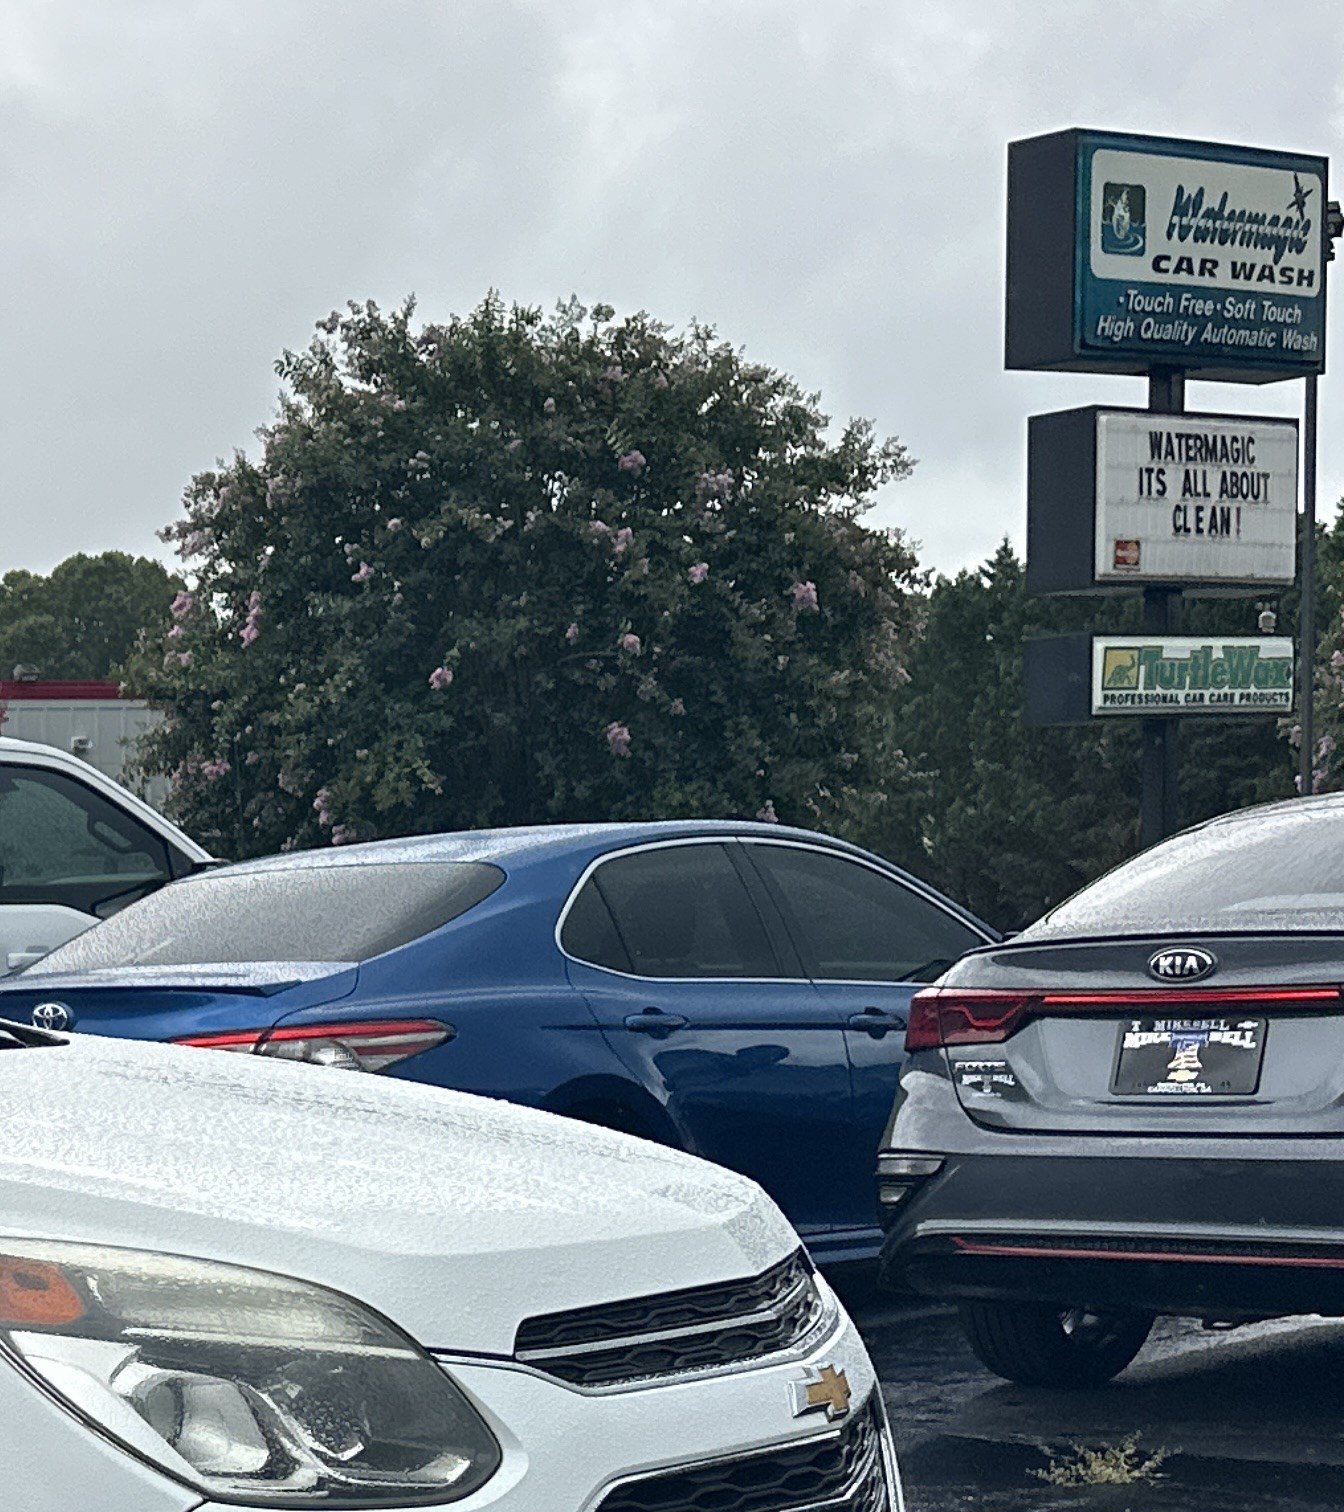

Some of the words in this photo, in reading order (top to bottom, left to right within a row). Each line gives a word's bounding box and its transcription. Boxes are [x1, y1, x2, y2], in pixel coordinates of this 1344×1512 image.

[1165, 182, 1312, 265] Watermagic
[1151, 254, 1219, 279] CAR
[1229, 260, 1316, 288] WASH
[1127, 289, 1174, 314] Touch
[1179, 293, 1214, 316] Free
[1223, 297, 1256, 320] Soft
[1261, 302, 1302, 324] Touch
[1096, 315, 1135, 342] High
[1140, 317, 1197, 346] Quality
[1200, 321, 1277, 349] Automatic
[1282, 329, 1318, 352] Wash
[1149, 431, 1256, 464] WATERMAGIC
[1139, 467, 1167, 497] ITS
[1181, 469, 1211, 499] ALL
[1218, 470, 1271, 501] ABOUT
[1103, 692, 1180, 705] PROFESSIONAL
[1184, 692, 1206, 705] CAR
[1208, 692, 1236, 705] CARE
[1238, 691, 1290, 705] PRODUCTS
[1158, 955, 1201, 976] KIA
